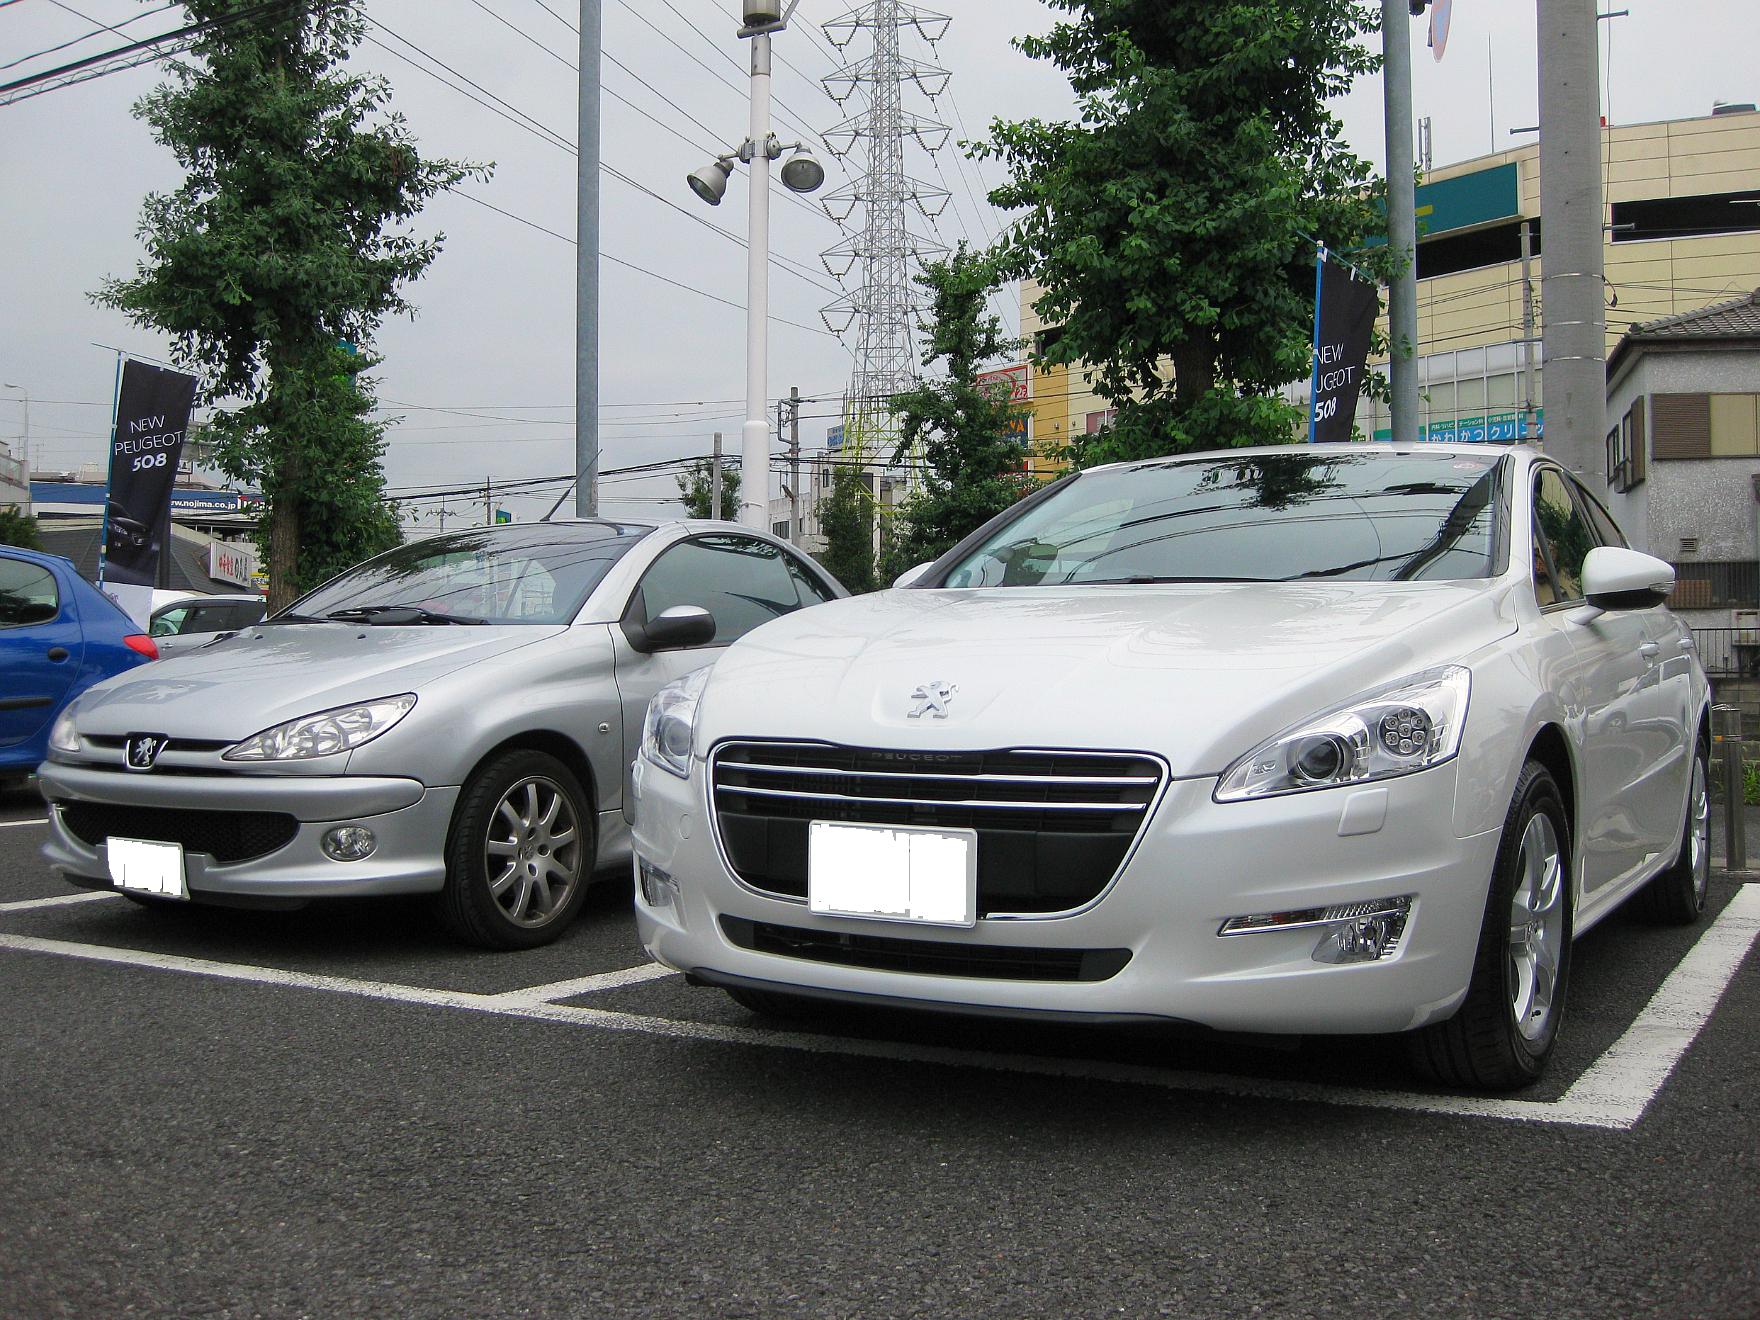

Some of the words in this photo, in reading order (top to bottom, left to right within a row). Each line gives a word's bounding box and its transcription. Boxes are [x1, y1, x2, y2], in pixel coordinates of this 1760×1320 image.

[1317, 342, 1344, 364] NEW
[1314, 396, 1337, 422] 508
[130, 415, 165, 433] NEW
[115, 430, 183, 456] PEUGEOT
[132, 452, 167, 472] 508
[871, 751, 963, 762] PEUGEOT
